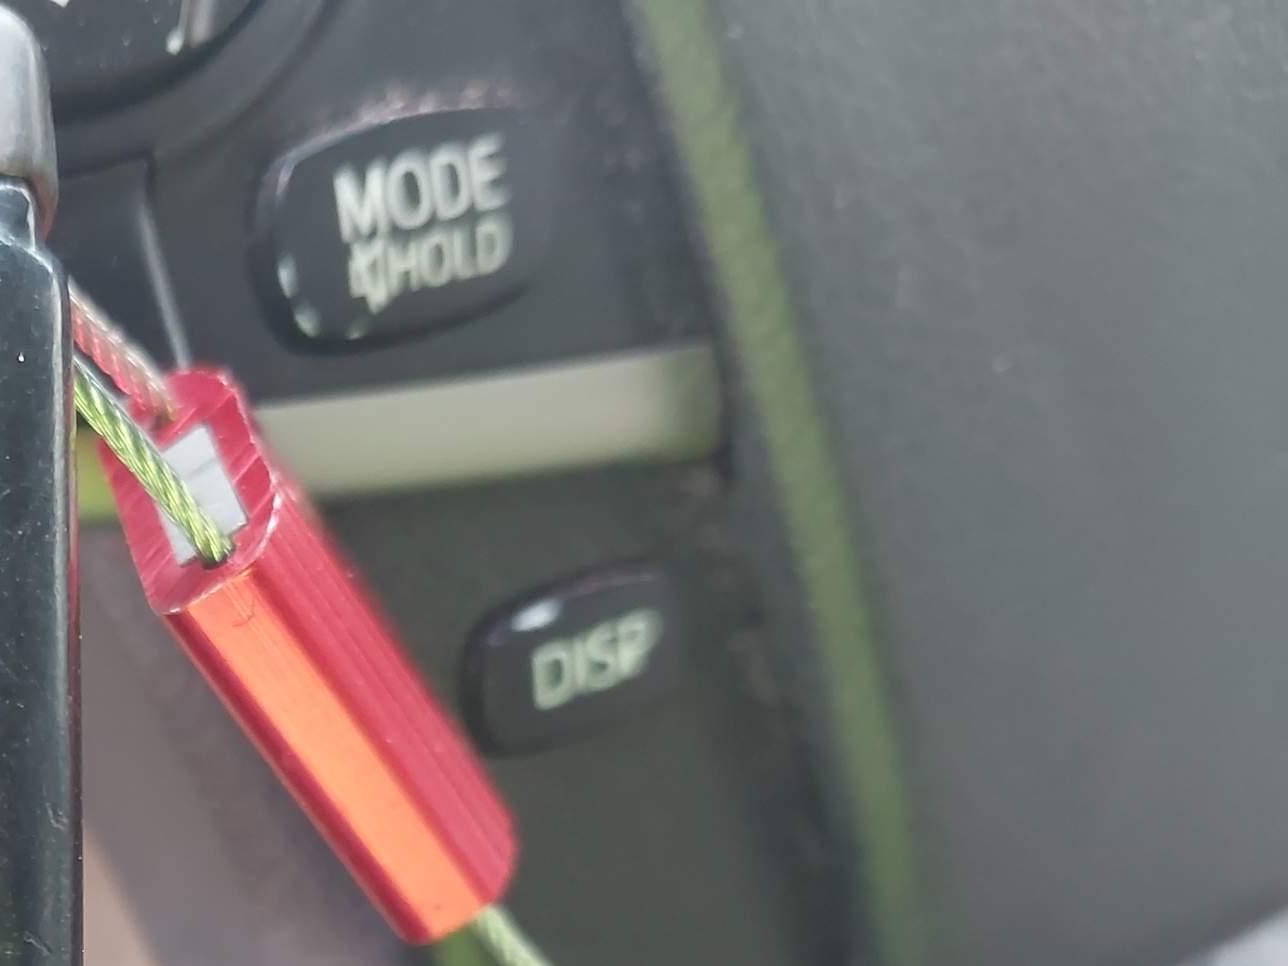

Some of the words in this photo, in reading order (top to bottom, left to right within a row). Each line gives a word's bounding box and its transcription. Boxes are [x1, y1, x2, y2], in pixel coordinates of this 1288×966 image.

[333, 135, 507, 242] MODE
[382, 220, 510, 294] HOLD
[530, 608, 664, 710] DISP
